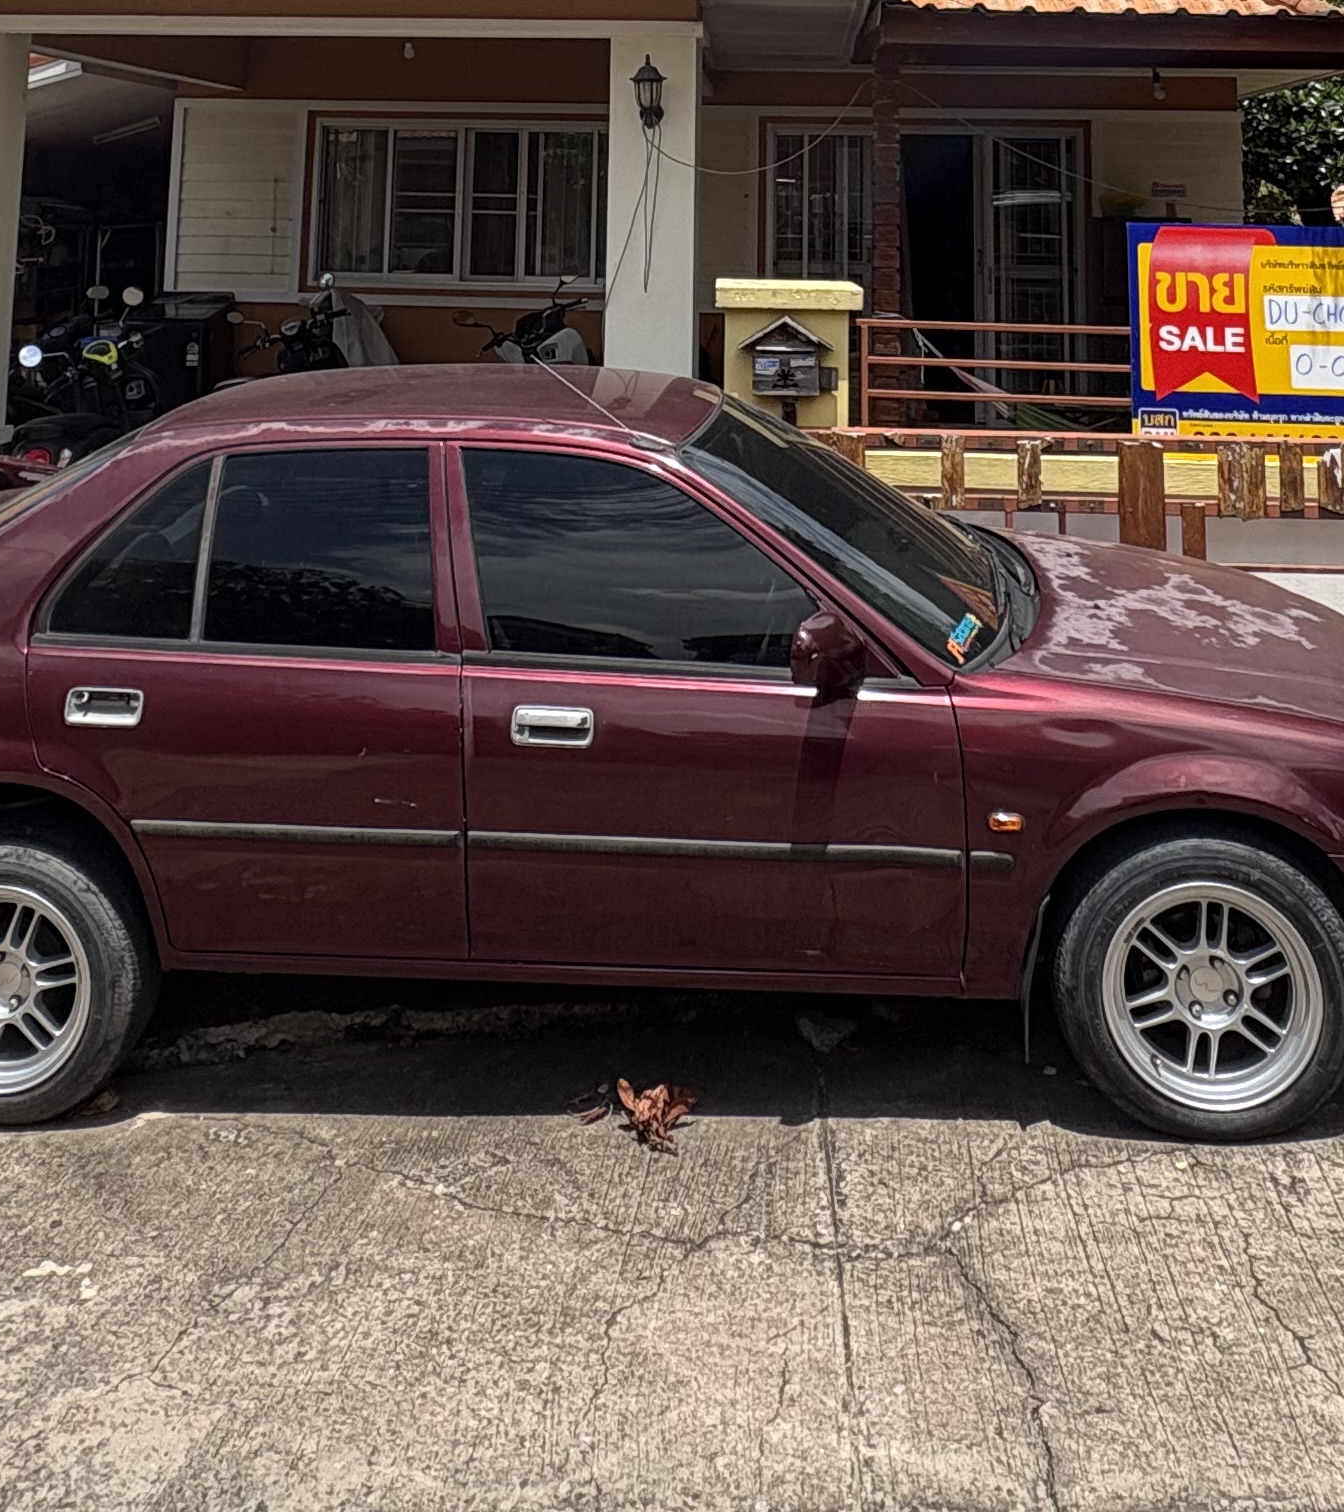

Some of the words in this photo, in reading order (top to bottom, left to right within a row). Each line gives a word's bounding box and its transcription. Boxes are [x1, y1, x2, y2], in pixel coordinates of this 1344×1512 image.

[1155, 271, 1246, 314] ขาย
[1158, 325, 1246, 353] SALE
[1142, 413, 1175, 427] บสก
